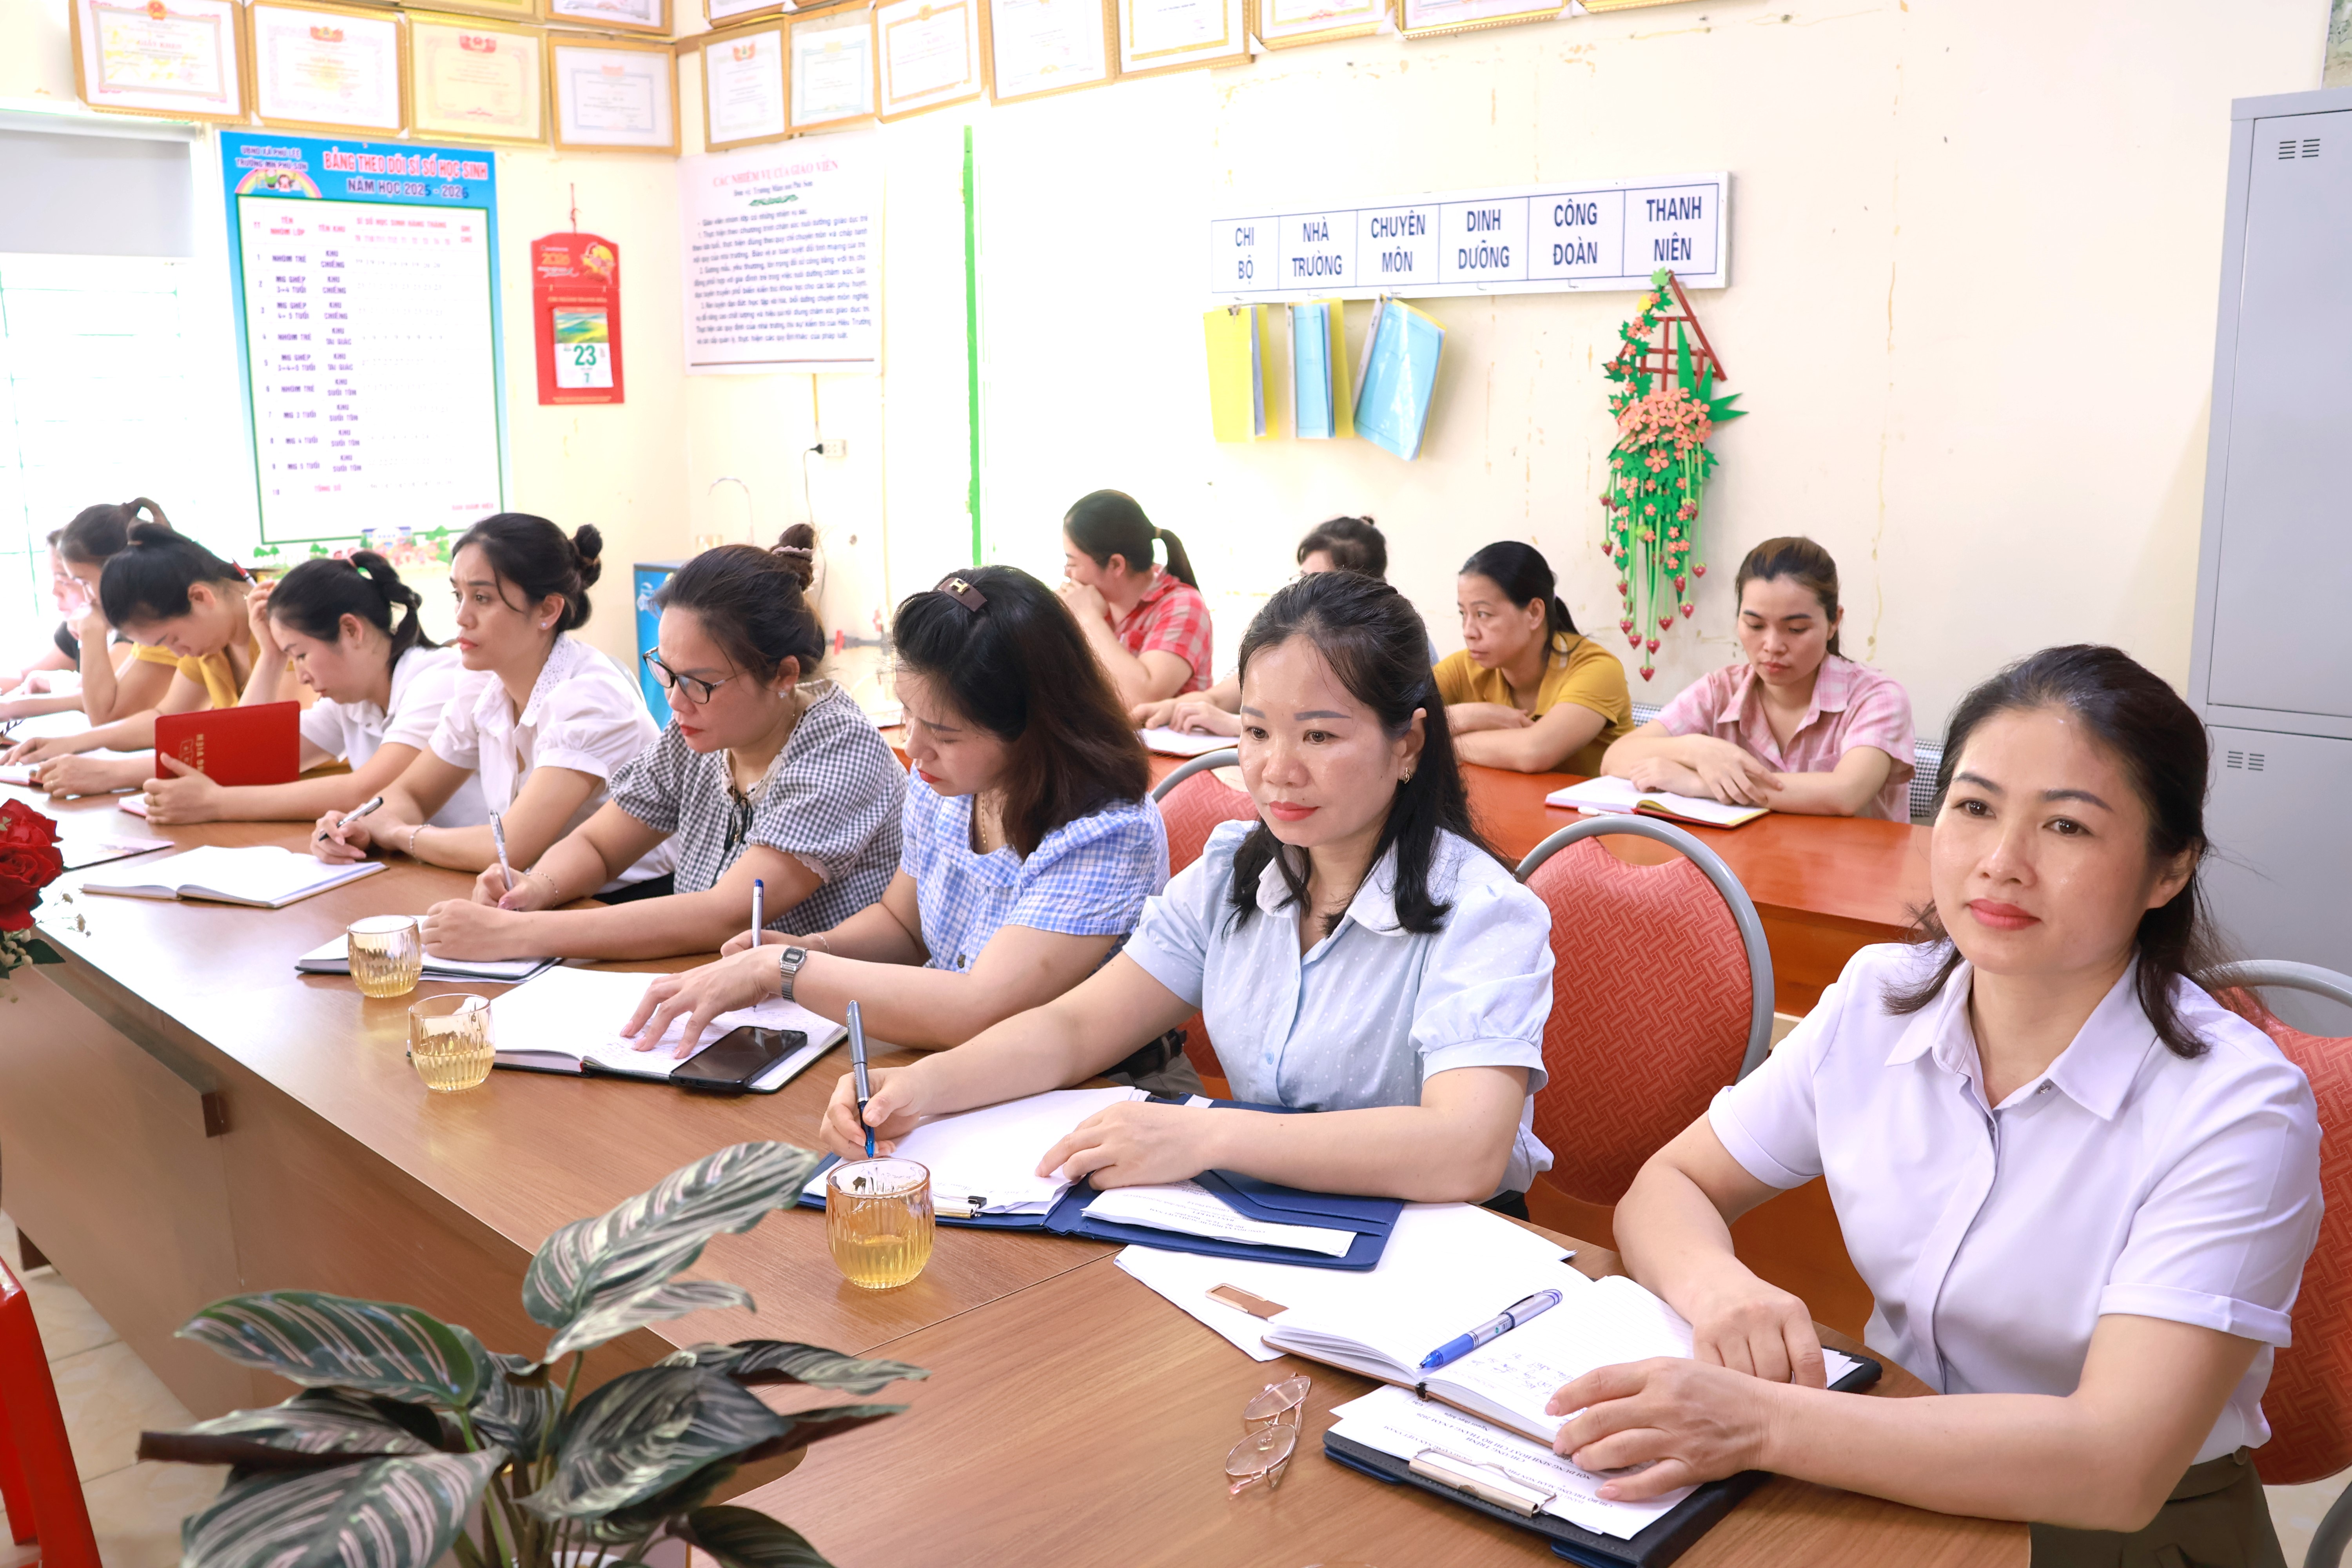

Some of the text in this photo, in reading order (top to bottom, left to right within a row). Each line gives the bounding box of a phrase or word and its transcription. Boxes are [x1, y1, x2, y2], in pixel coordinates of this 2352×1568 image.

[324, 147, 488, 181] BẢNG THEO DÕI SĨ SỐ HỌC SINH
[348, 176, 374, 192] NĂM
[379, 180, 400, 197] HỌC
[405, 182, 431, 196] 2025
[442, 185, 469, 198] 2026
[1467, 209, 1501, 232] DINH
[1554, 199, 1597, 227] CÔNG
[1646, 196, 1701, 221] THANH
[1236, 227, 1254, 247] CHI
[1303, 216, 1330, 243] NHÀ
[1371, 210, 1426, 239] CHUYÊN
[1382, 246, 1412, 272] MÔN
[1459, 240, 1509, 269] DƯỠNG
[1553, 236, 1597, 265] ĐOÀN
[1654, 232, 1691, 261] NIÊN
[1238, 255, 1253, 284] BỘ
[1292, 250, 1342, 276] TRƯỜNG
[573, 344, 597, 366] 23
[1532, 1457, 1552, 1466] SINH
[1553, 1465, 1576, 1475] DUNG
